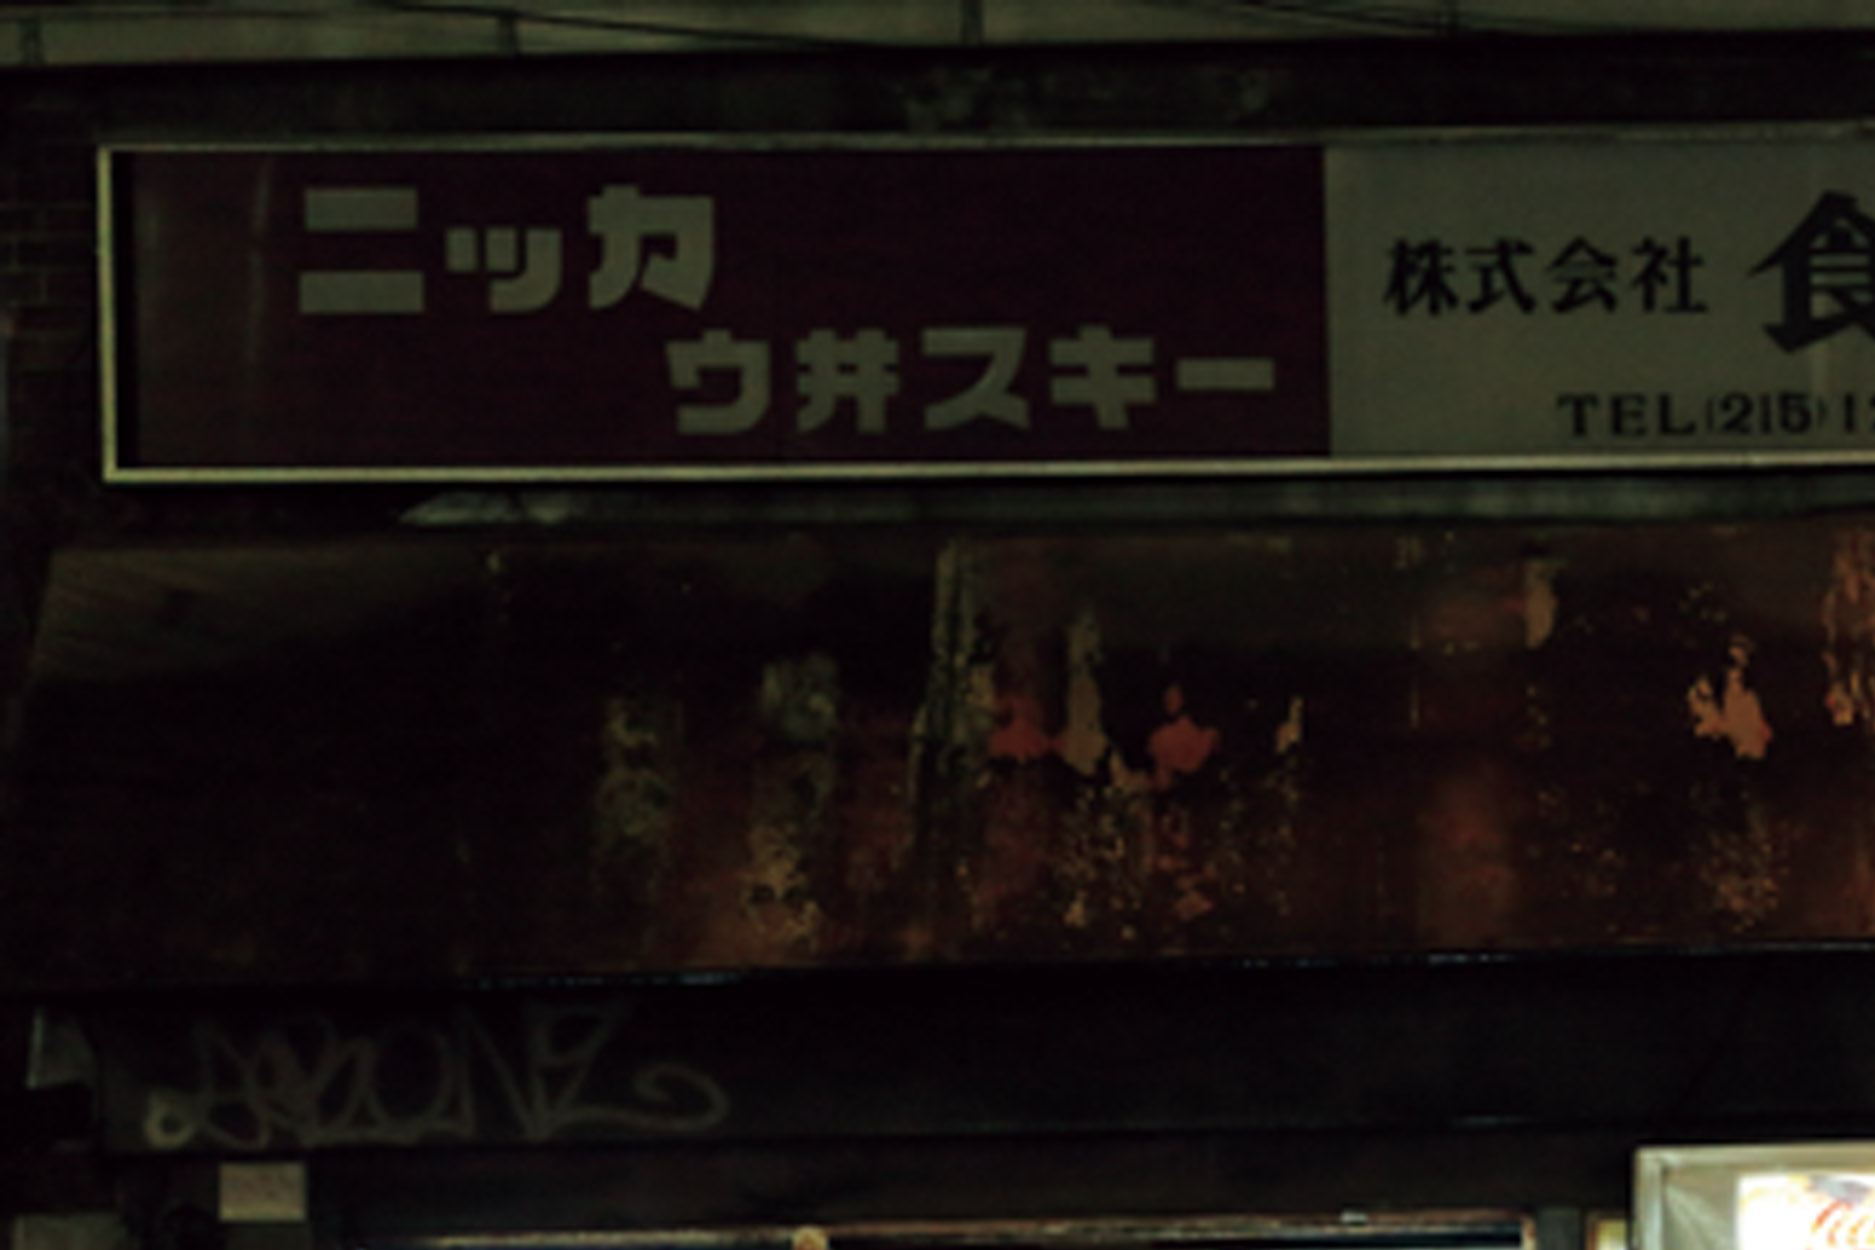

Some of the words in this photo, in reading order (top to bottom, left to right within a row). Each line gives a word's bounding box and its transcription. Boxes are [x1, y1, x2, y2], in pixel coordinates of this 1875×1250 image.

[297, 182, 717, 317] ニッカ
[1383, 234, 1708, 317] 株式会社
